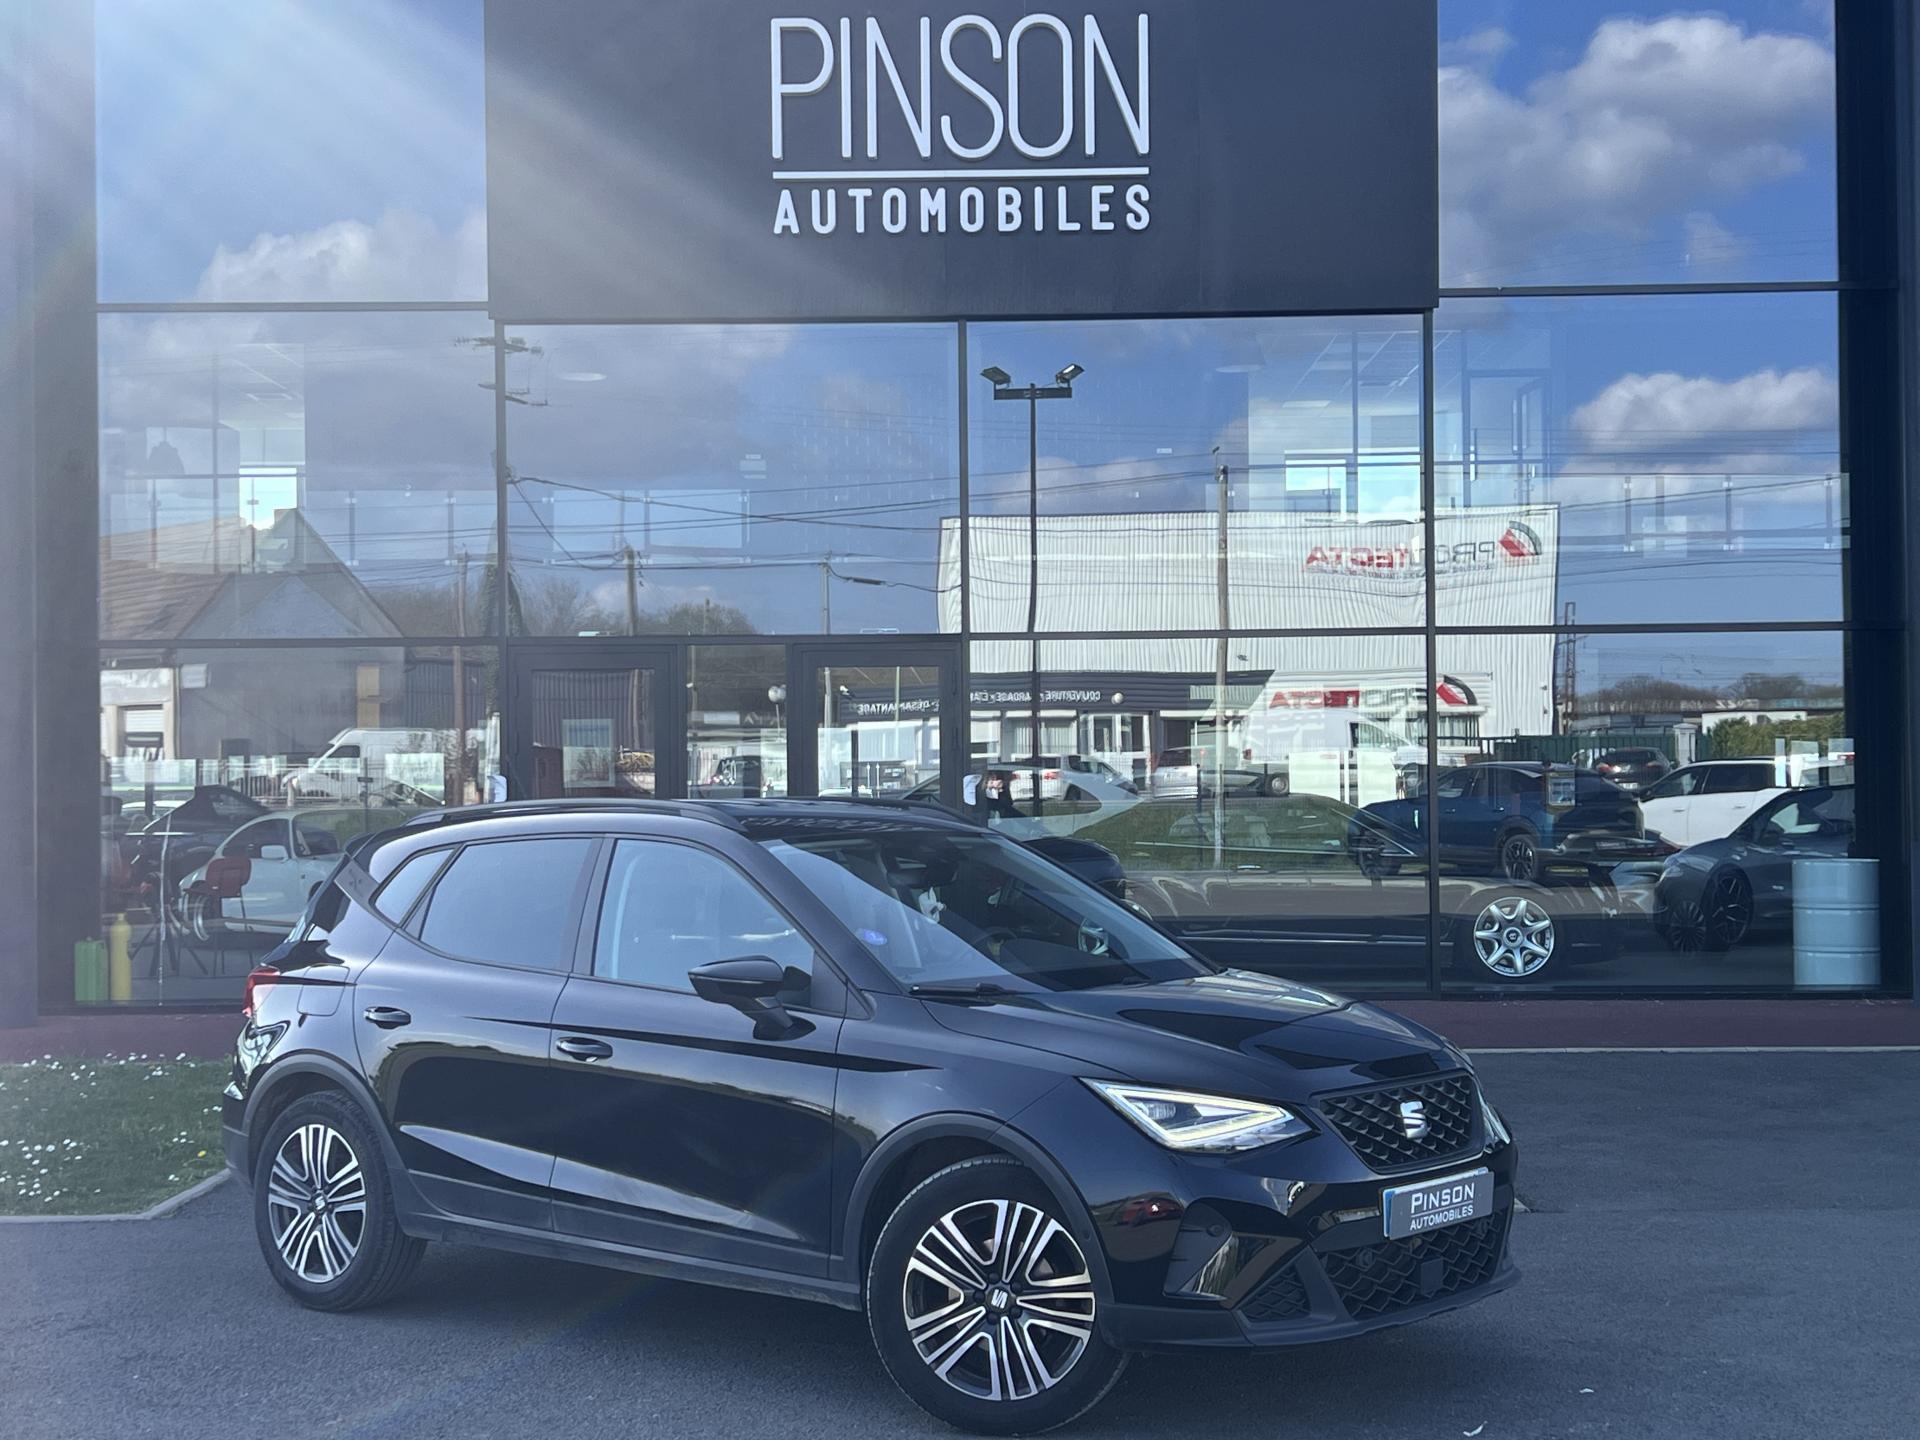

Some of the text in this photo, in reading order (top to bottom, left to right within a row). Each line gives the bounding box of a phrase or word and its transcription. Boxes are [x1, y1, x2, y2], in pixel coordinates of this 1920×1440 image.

[770, 13, 1150, 160] PINSON
[773, 184, 1150, 234] AUTOMOBILES
[1409, 1204, 1474, 1231] AUTOMOBILES
[1410, 1182, 1475, 1214] PINSON
